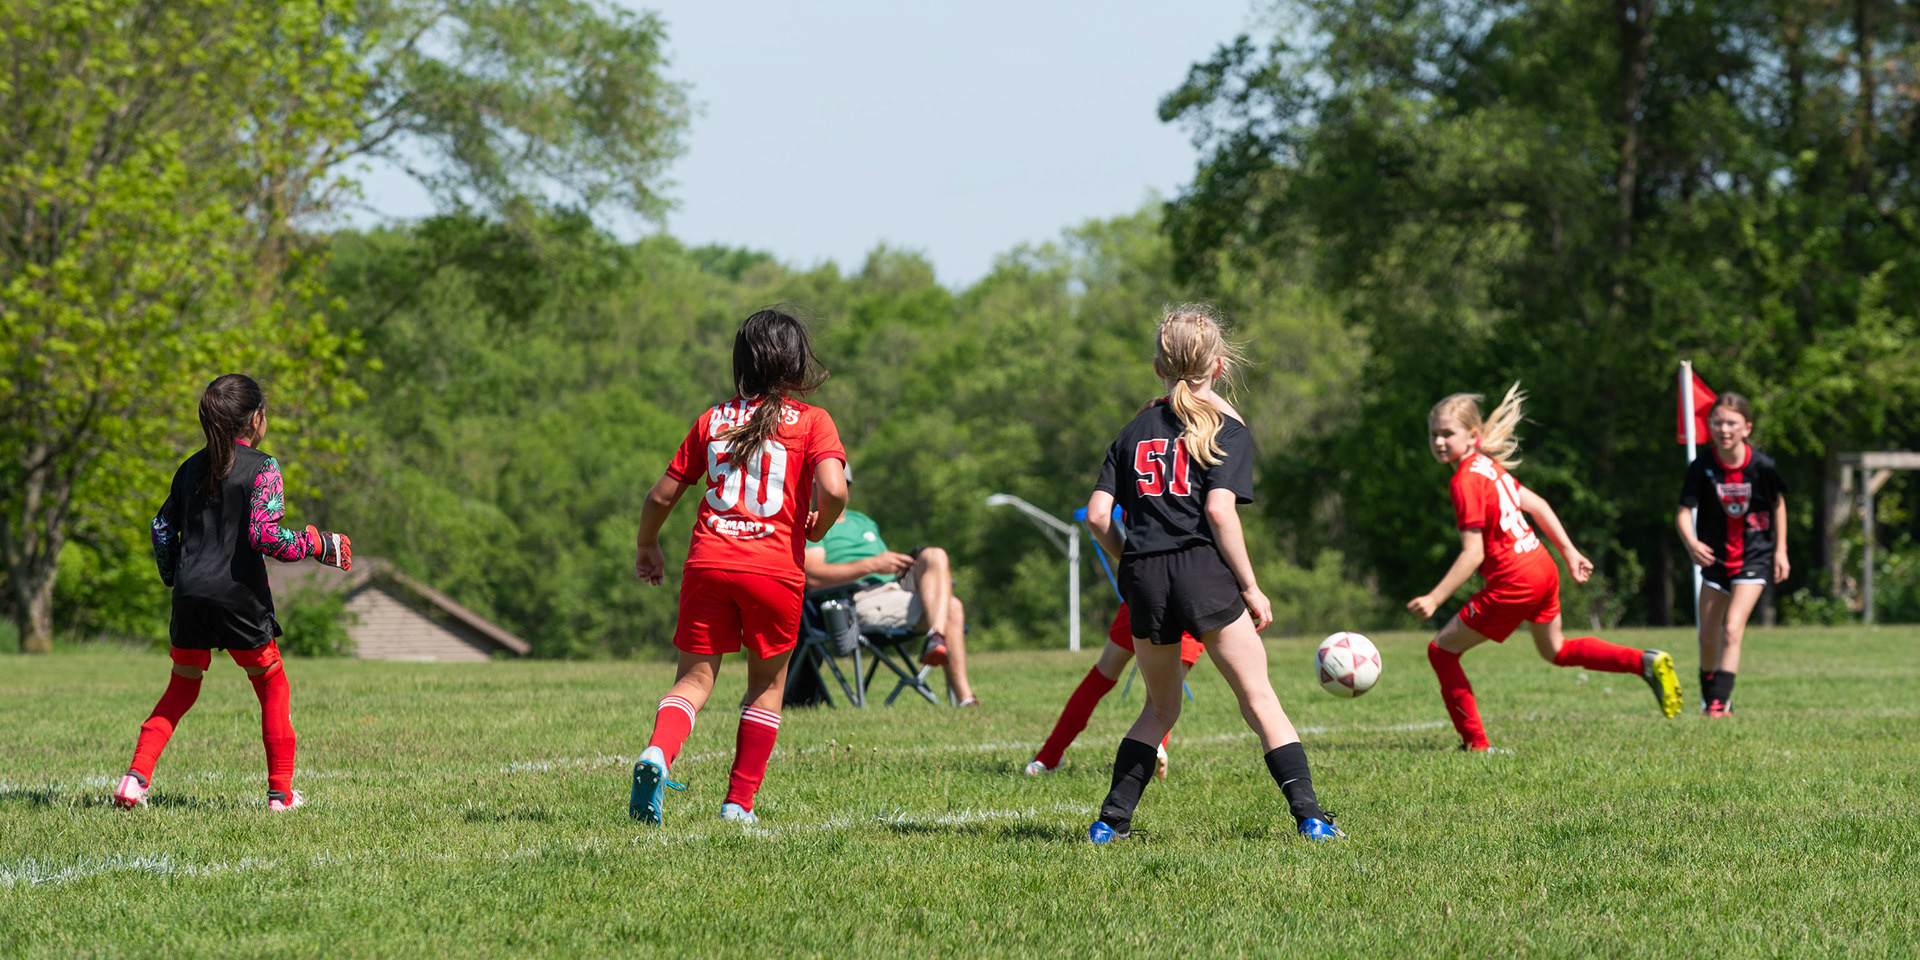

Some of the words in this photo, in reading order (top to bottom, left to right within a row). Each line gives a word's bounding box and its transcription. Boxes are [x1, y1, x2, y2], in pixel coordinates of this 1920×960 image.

[706, 440, 787, 517] 50
[1134, 437, 1191, 498] 51
[717, 519, 763, 533] SMART
